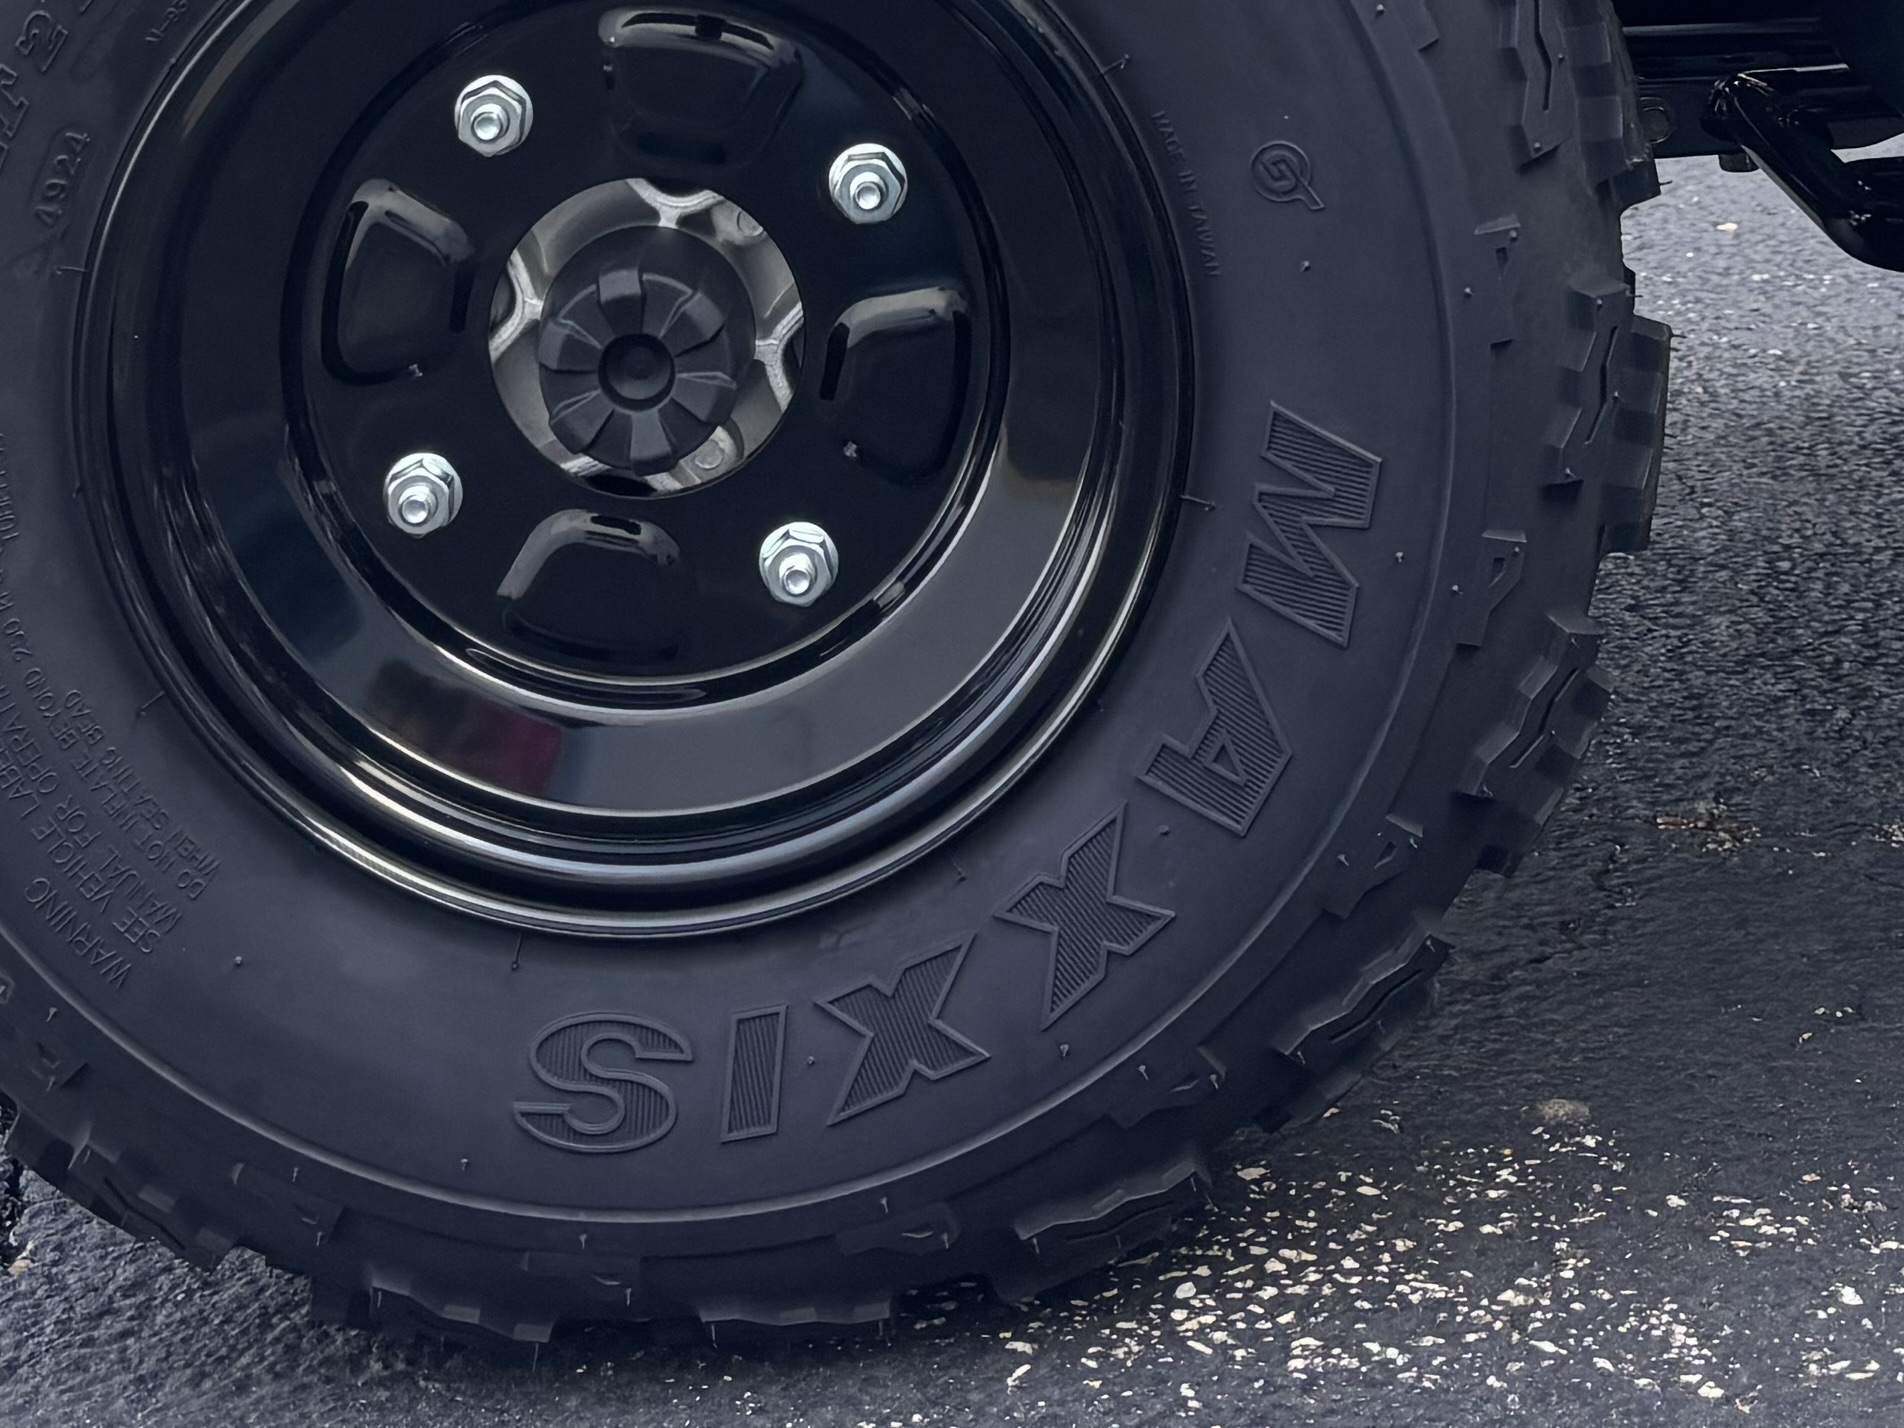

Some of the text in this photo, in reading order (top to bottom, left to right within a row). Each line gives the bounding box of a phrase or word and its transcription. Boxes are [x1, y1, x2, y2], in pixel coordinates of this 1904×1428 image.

[34, 123, 92, 227] 4924
[22, 666, 85, 752] BEYOND
[64, 688, 105, 749] BEAD
[512, 399, 1383, 1153] MAXXIS
[30, 816, 114, 915] VEHICLE
[54, 797, 102, 851] FOR
[26, 876, 132, 988] WARNING
[98, 849, 183, 936] MANUAL
[111, 906, 161, 956] SEE
